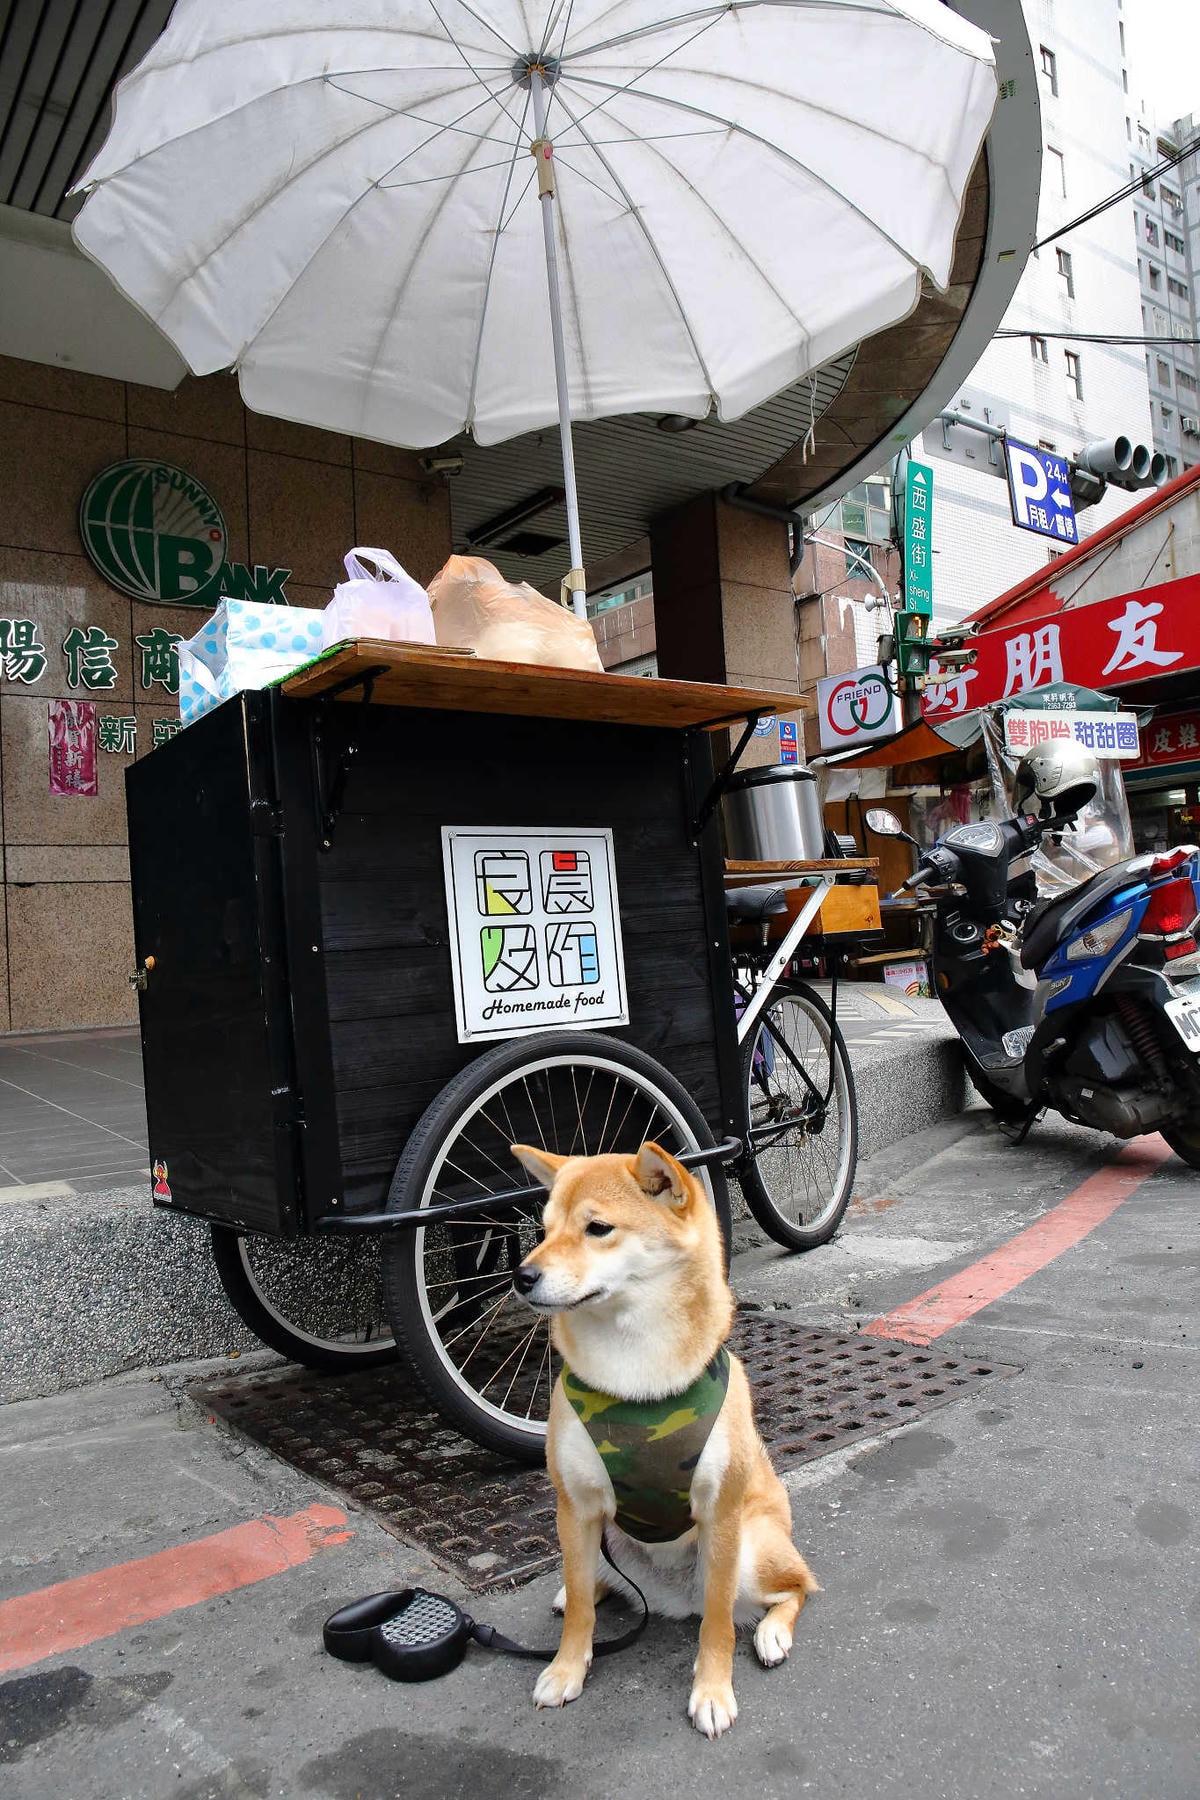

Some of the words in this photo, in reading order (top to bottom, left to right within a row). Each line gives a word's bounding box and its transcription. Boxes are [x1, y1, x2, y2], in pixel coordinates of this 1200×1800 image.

[155, 466, 222, 528] SUNNY
[1008, 445, 1048, 525] P
[912, 485, 927, 568] 西盛街
[159, 533, 293, 608] BANK
[910, 584, 930, 603] sheng
[924, 600, 1185, 713] 好朋友
[836, 684, 882, 703] FRIEND
[1007, 718, 1071, 747] 雙胞胎
[1074, 721, 1139, 750] 甜甜圈
[482, 993, 571, 1020] Homemade
[573, 990, 605, 1014] food
[1173, 1006, 1200, 1040] MC
